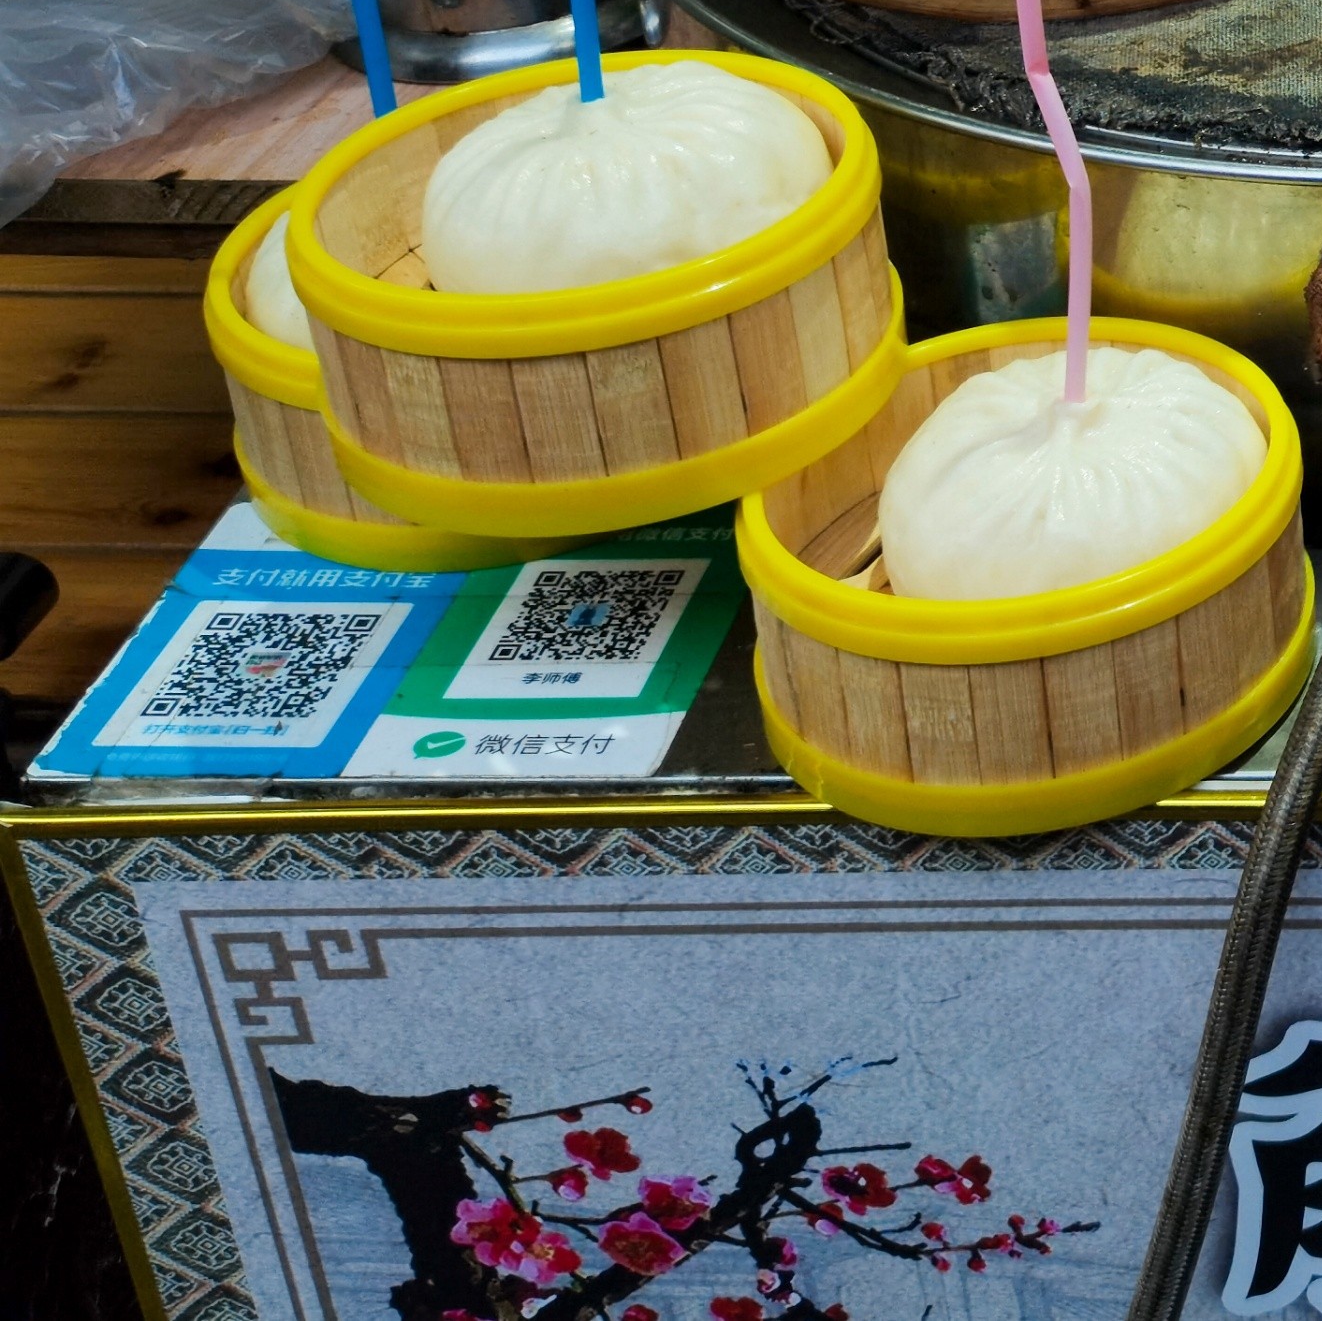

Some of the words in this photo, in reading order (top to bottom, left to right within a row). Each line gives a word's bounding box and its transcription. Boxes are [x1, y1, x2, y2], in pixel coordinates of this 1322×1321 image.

[212, 568, 438, 590] 支付就用支付宝
[521, 671, 583, 685] 李师傅
[474, 733, 617, 756] 微信支付
